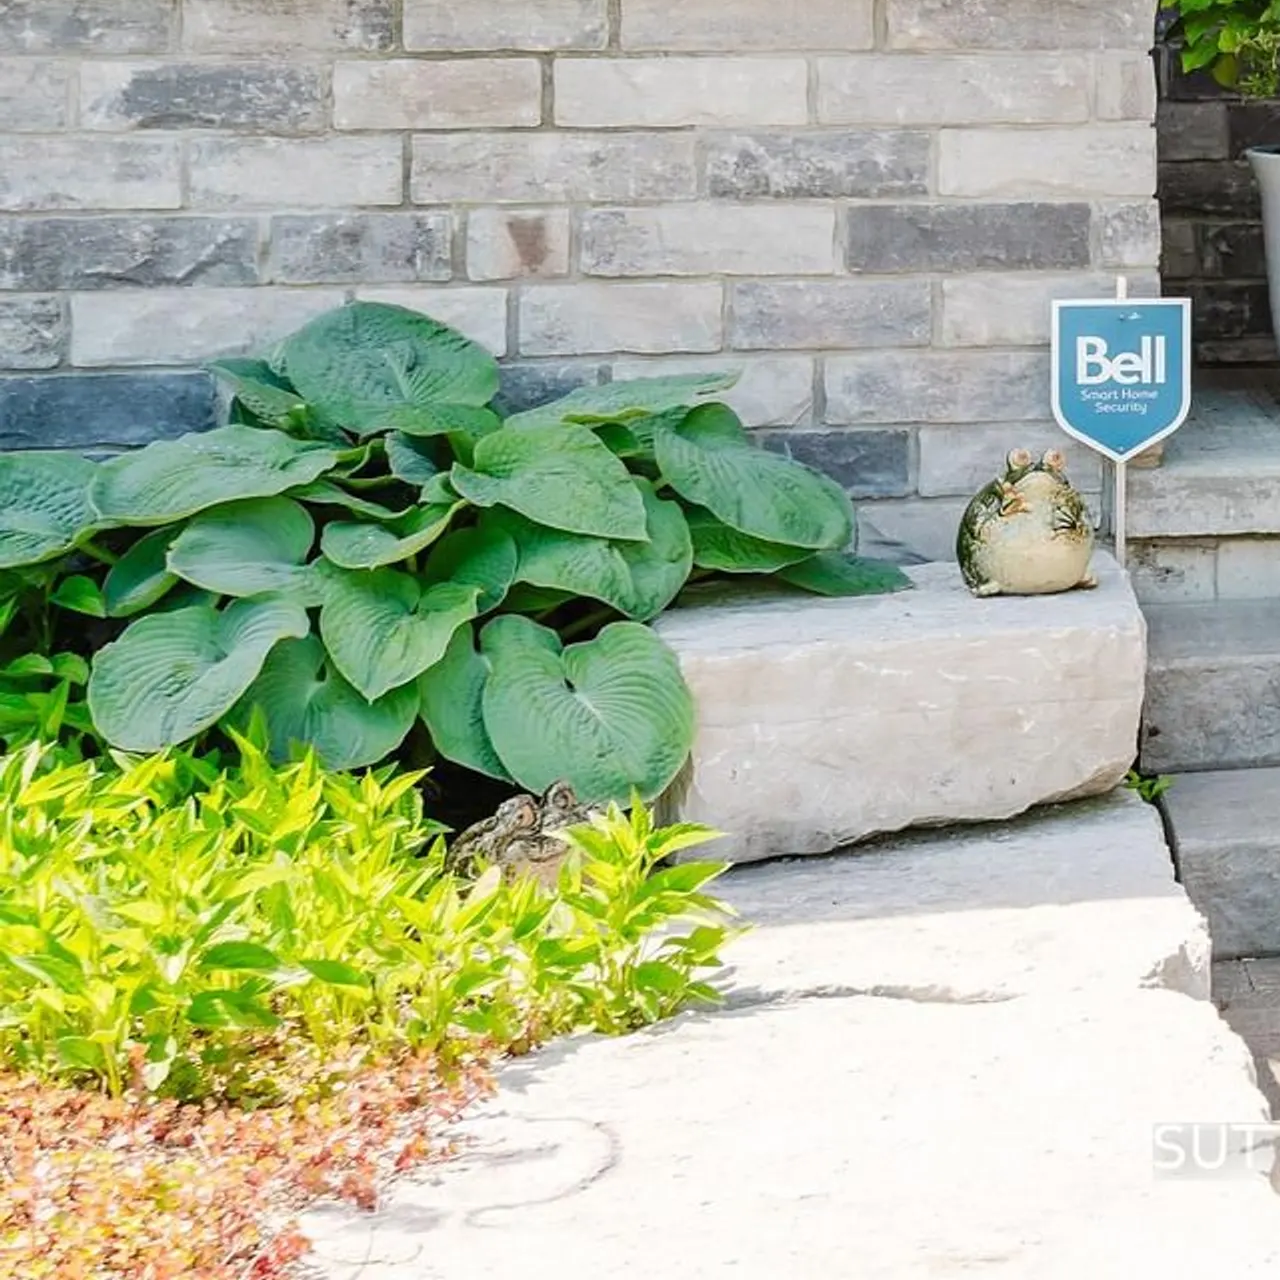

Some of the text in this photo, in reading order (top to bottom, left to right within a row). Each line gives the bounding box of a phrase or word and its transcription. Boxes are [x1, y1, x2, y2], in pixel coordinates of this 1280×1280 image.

[1075, 335, 1166, 385] Bell
[1080, 389, 1158, 401] Smart Home
[1095, 402, 1147, 415] Security
